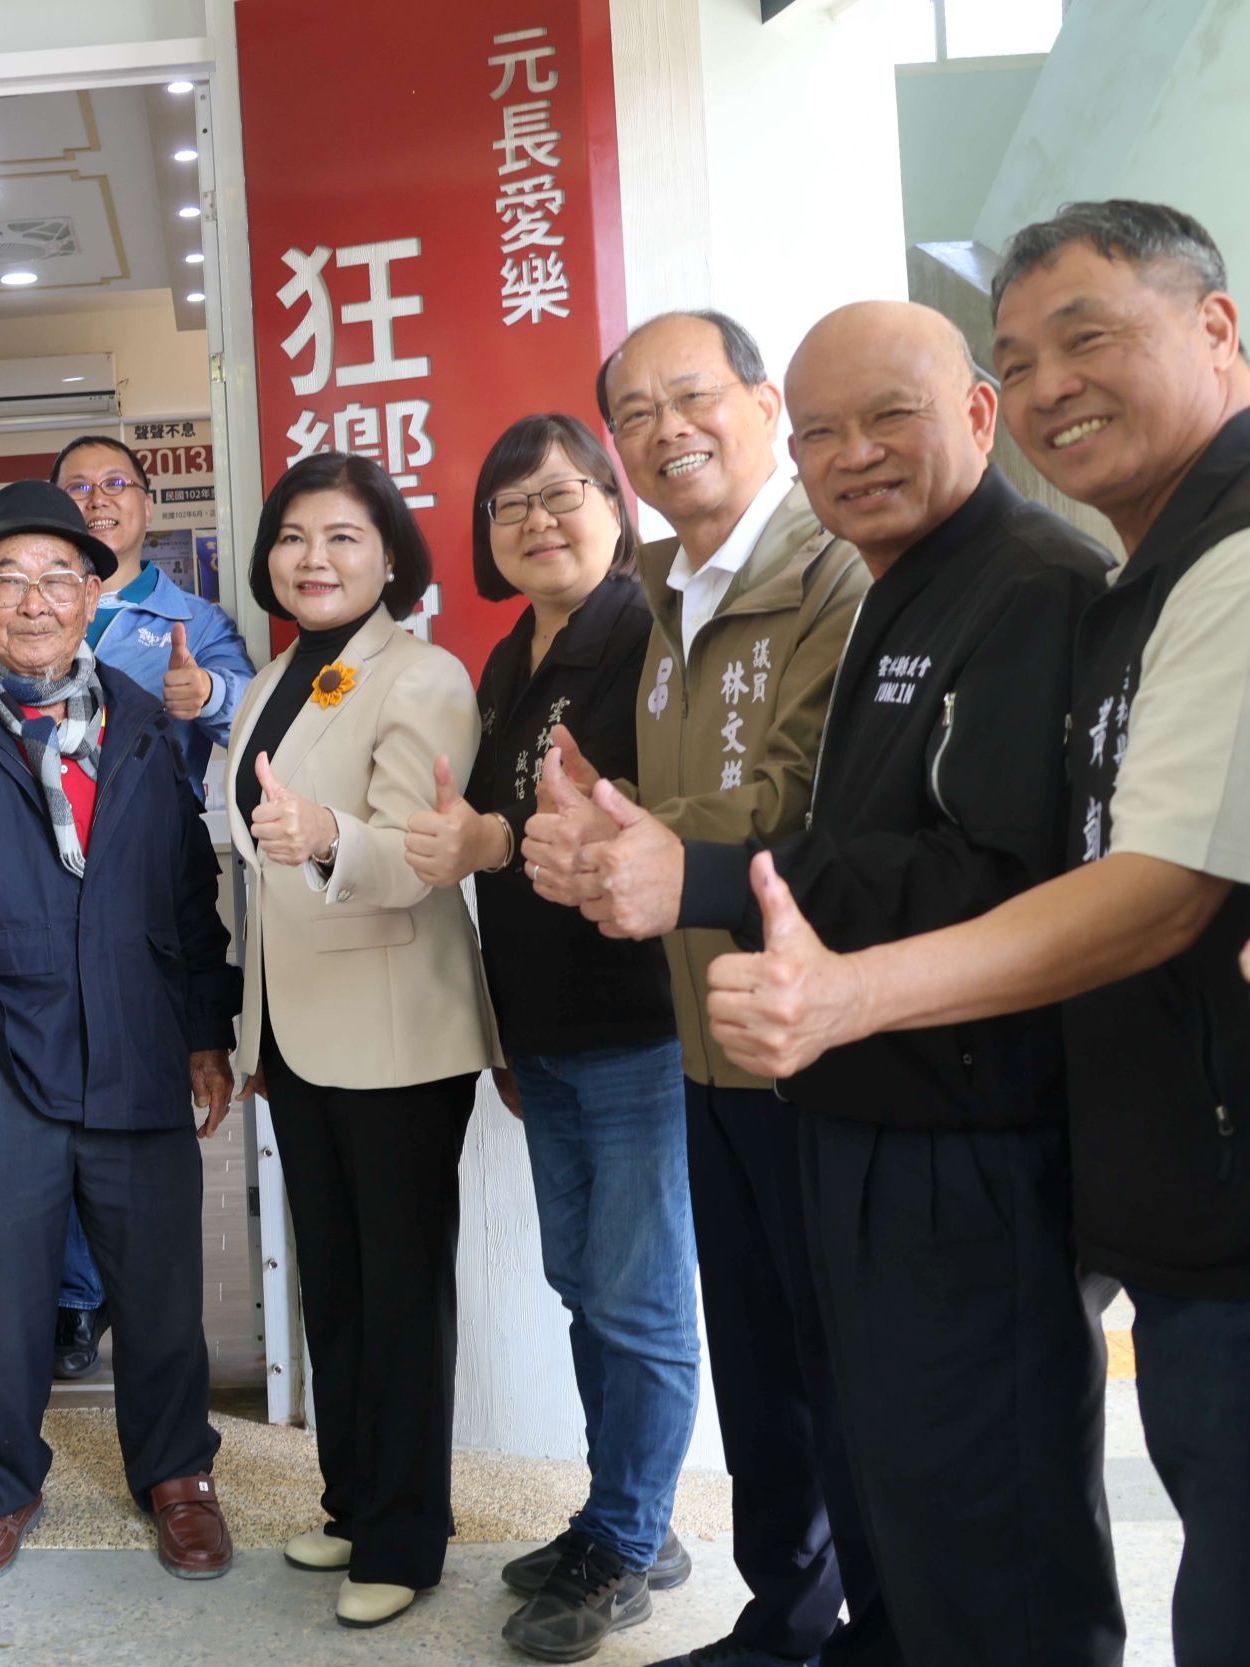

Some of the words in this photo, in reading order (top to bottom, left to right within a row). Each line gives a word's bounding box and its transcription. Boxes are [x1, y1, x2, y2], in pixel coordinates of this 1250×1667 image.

[488, 26, 571, 326] 元長愛樂
[134, 423, 196, 440] 聲聲不息
[136, 446, 207, 477] 2013
